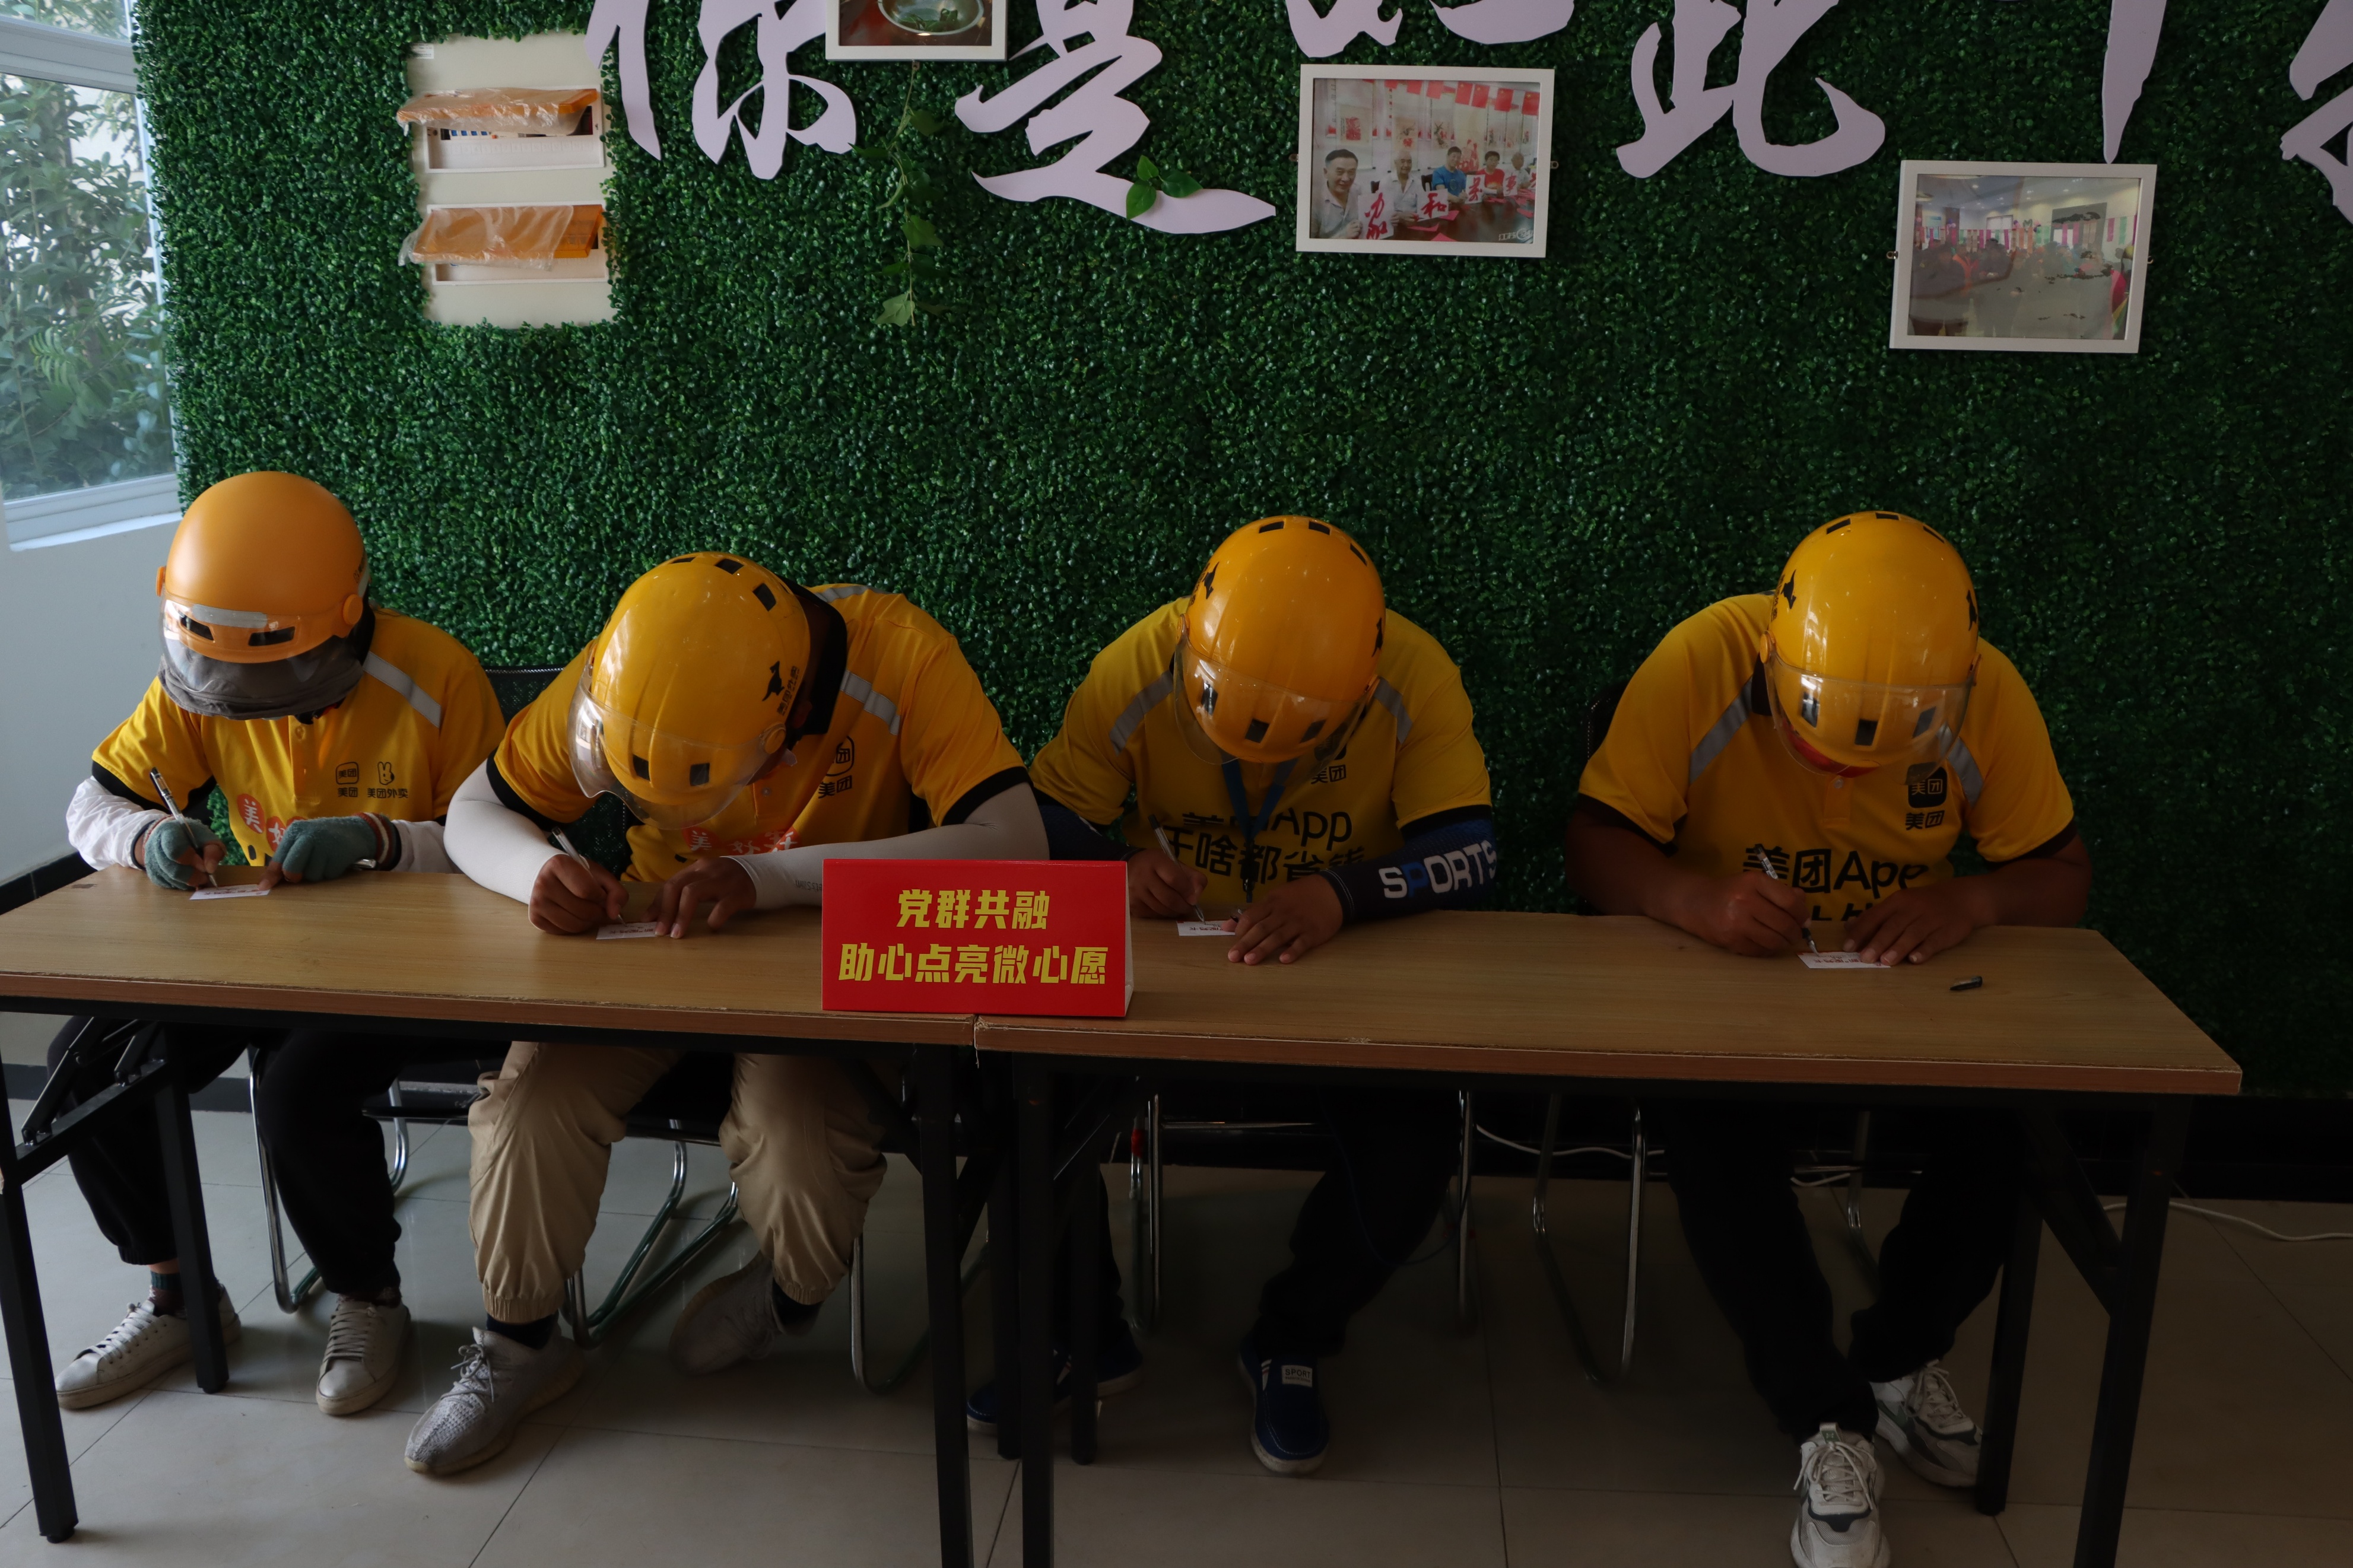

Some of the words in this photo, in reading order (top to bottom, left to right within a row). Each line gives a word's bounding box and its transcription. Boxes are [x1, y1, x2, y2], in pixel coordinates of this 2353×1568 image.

[338, 768, 357, 779] 美团
[337, 787, 358, 798] 美团
[366, 787, 409, 799] 美团外卖
[818, 774, 853, 799] 美团
[1910, 778, 1944, 796] 美团
[1904, 809, 1946, 831] 美团
[1377, 839, 1497, 899] SPORTS
[896, 889, 1050, 930] 党群共融
[837, 942, 1109, 985] 助心点亮微心愿
[1285, 1369, 1311, 1379] SPORT
